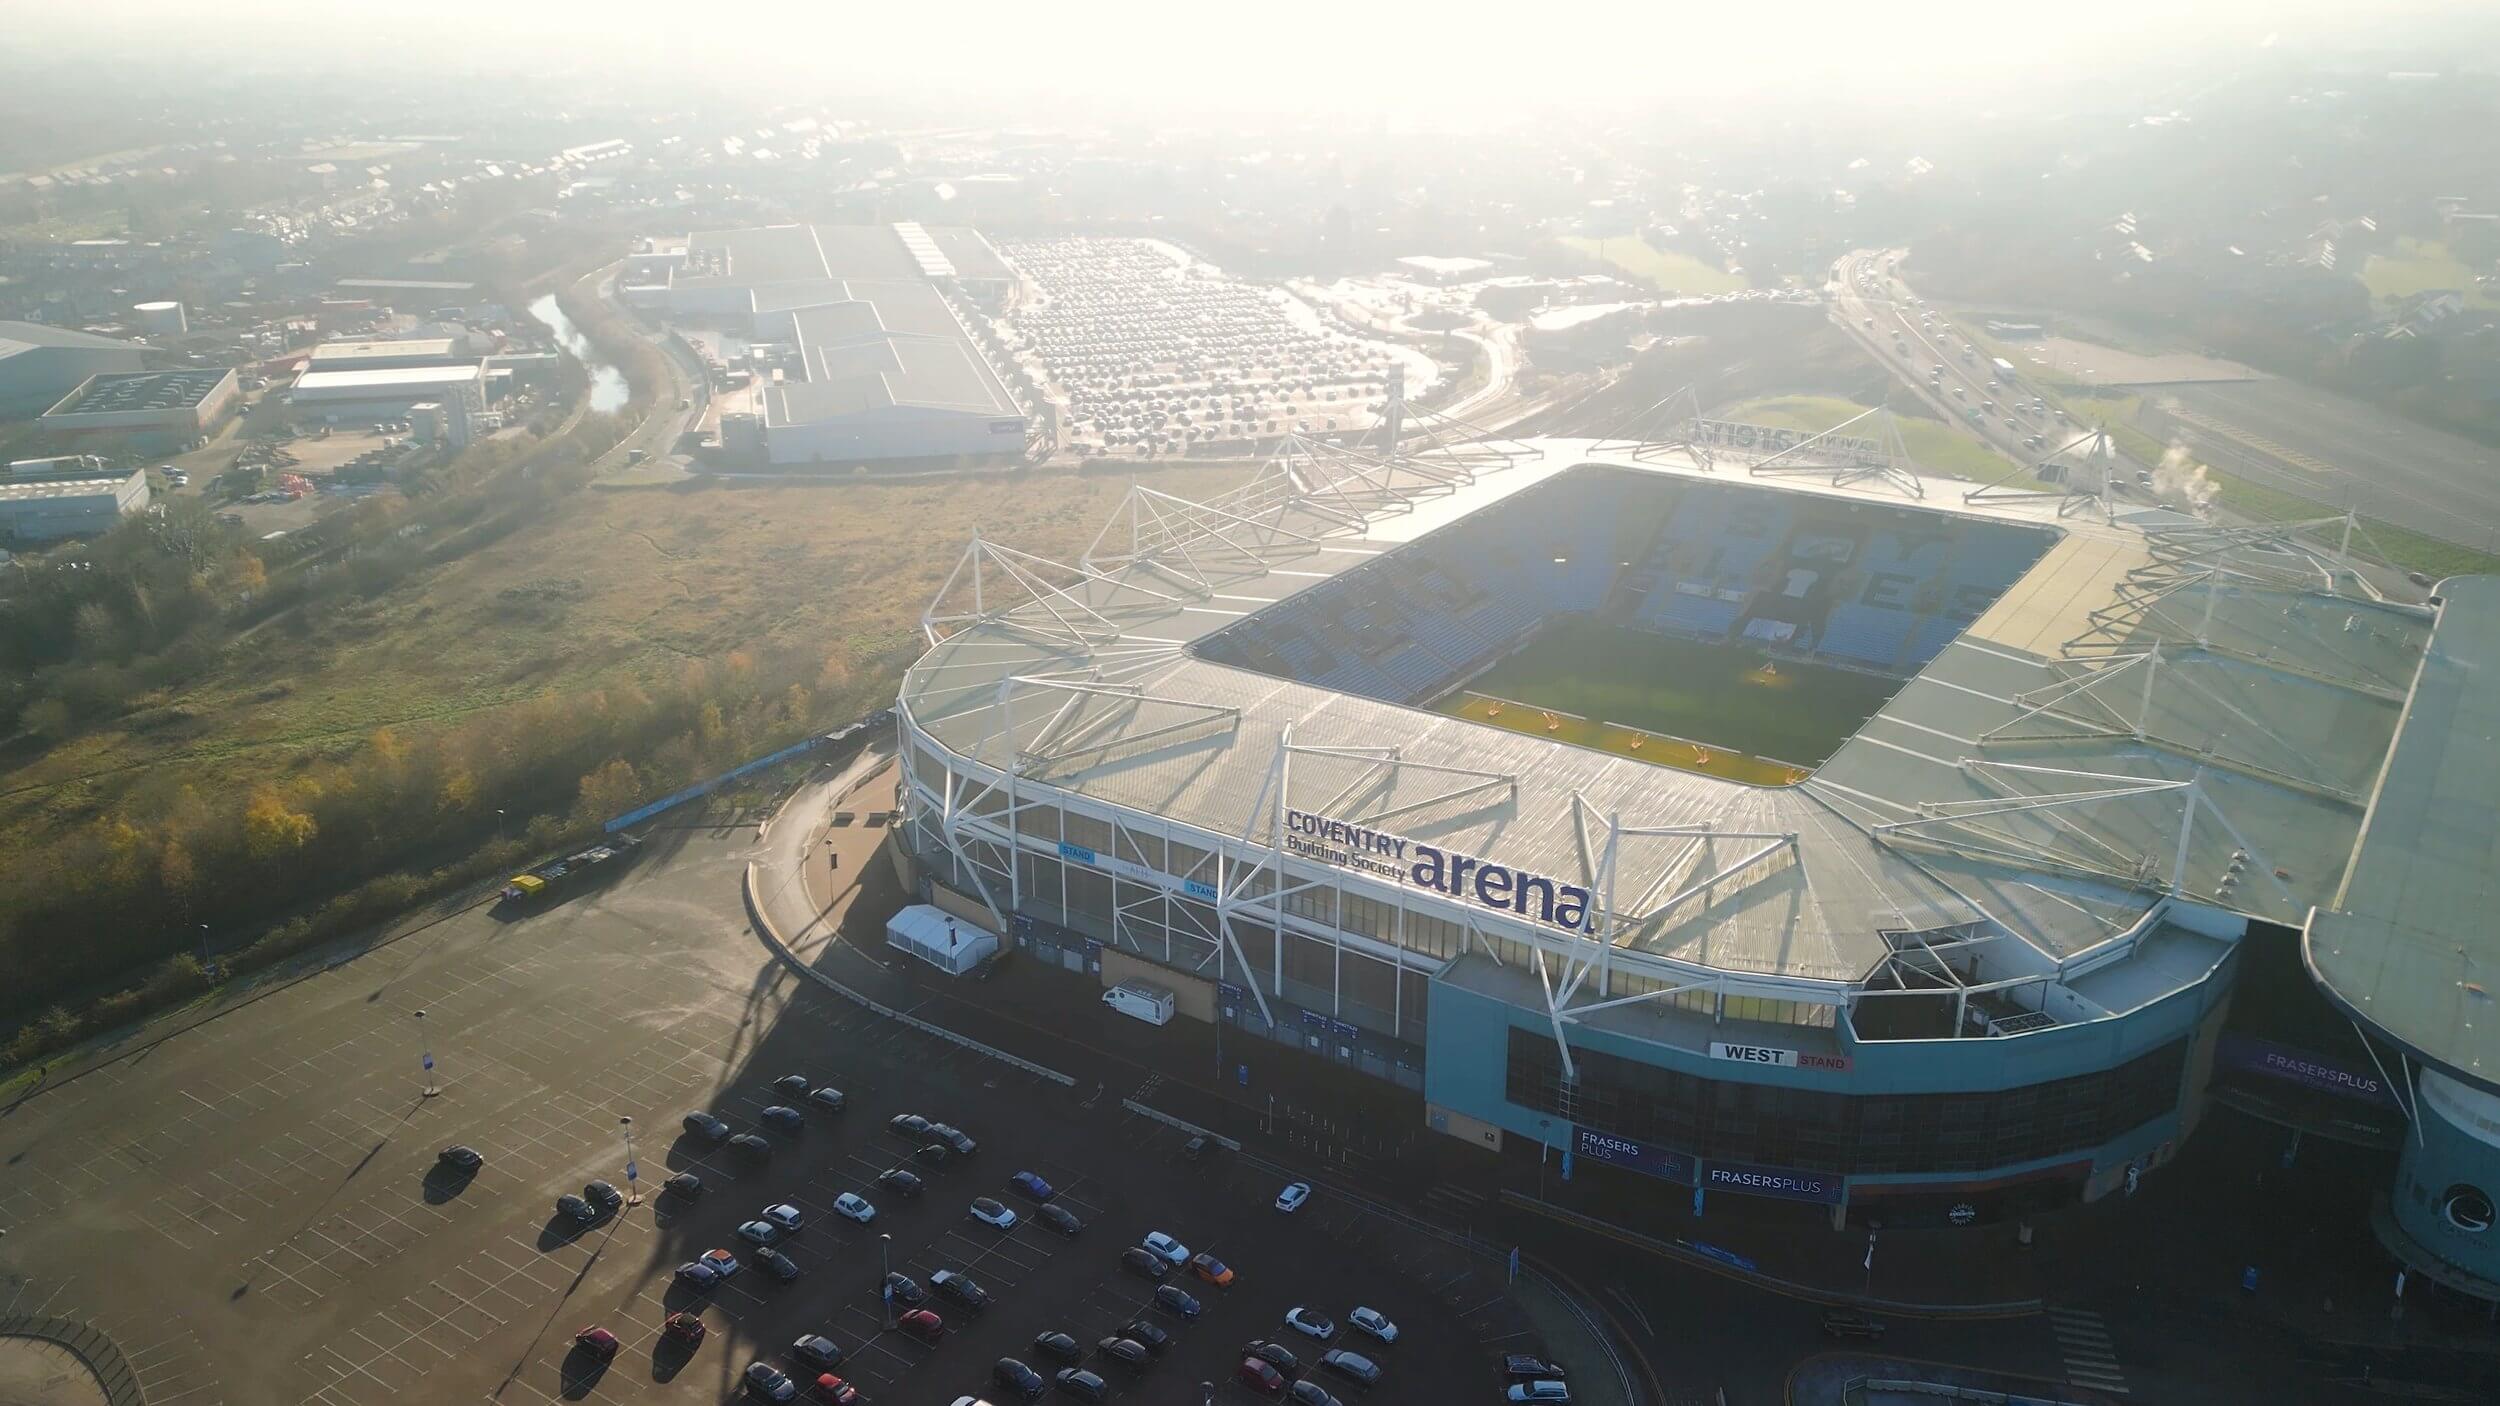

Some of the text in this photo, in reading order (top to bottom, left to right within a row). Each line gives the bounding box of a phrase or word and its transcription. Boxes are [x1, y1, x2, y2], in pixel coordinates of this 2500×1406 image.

[1287, 810, 1407, 859] COVENTRY
[1062, 845, 1091, 862] STAND
[1287, 834, 1406, 884] Building Society
[1190, 884, 1218, 900] STAND
[1411, 845, 1595, 934] arena
[1725, 1044, 1845, 1070] WEST STAND
[2266, 1053, 2378, 1092] FRASERSPLUS
[1581, 1143, 1612, 1160] PLUS
[1582, 1132, 1639, 1156] FRASERS
[1711, 1170, 1821, 1194] FRASERSPLUS
